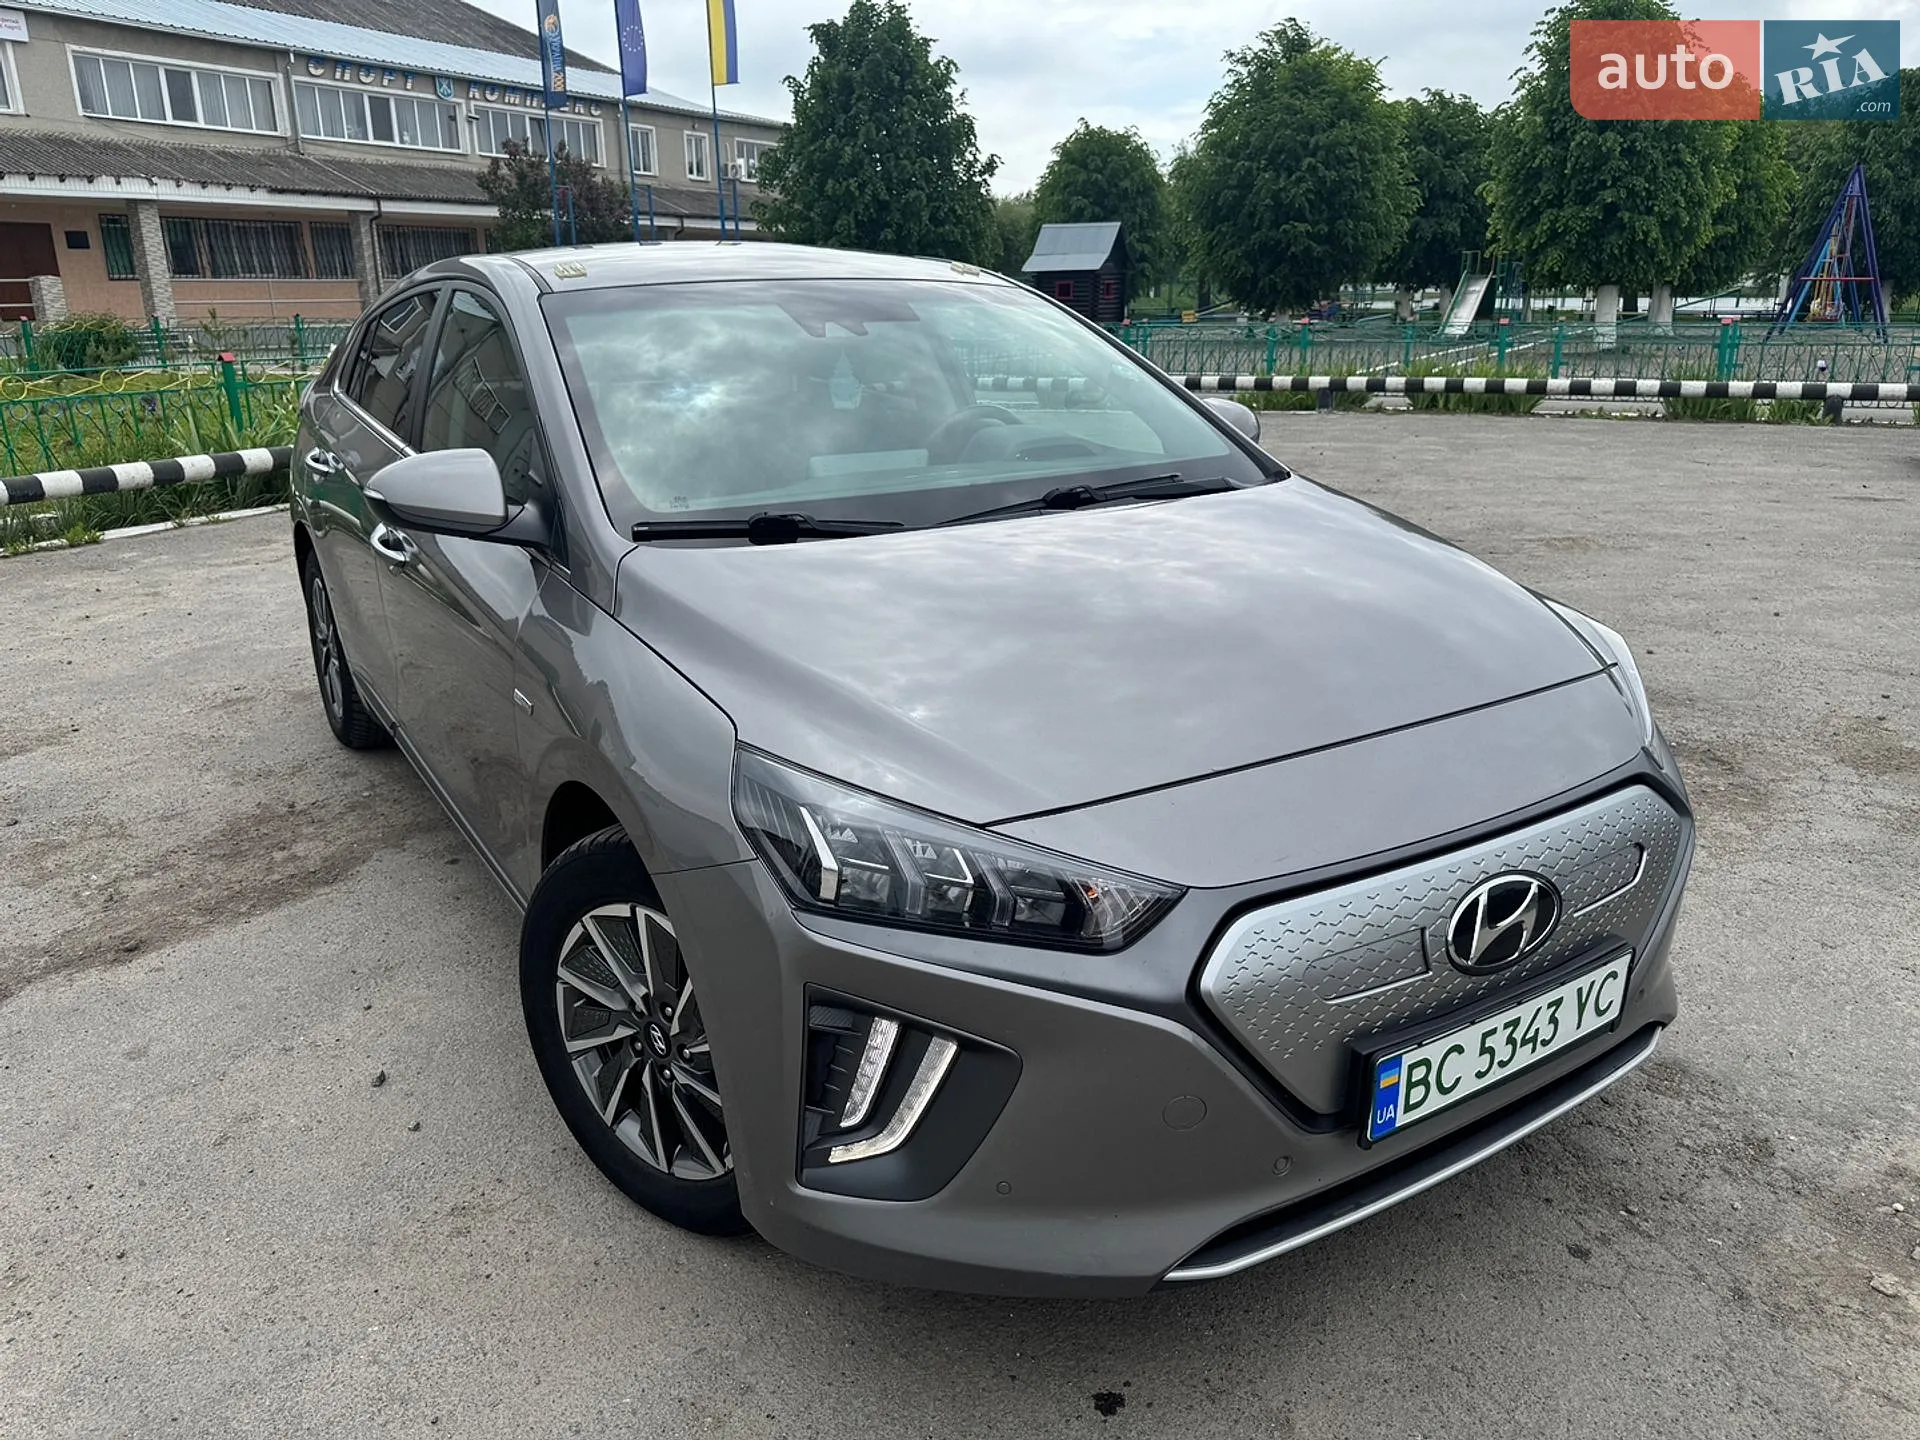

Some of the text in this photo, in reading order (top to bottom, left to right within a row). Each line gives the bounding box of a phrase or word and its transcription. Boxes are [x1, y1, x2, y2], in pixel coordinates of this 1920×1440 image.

[307, 56, 602, 116] СПОРТ КОМПКС
[1402, 970, 1619, 1115] BC 5343 YC
[1376, 1103, 1396, 1125] UA
